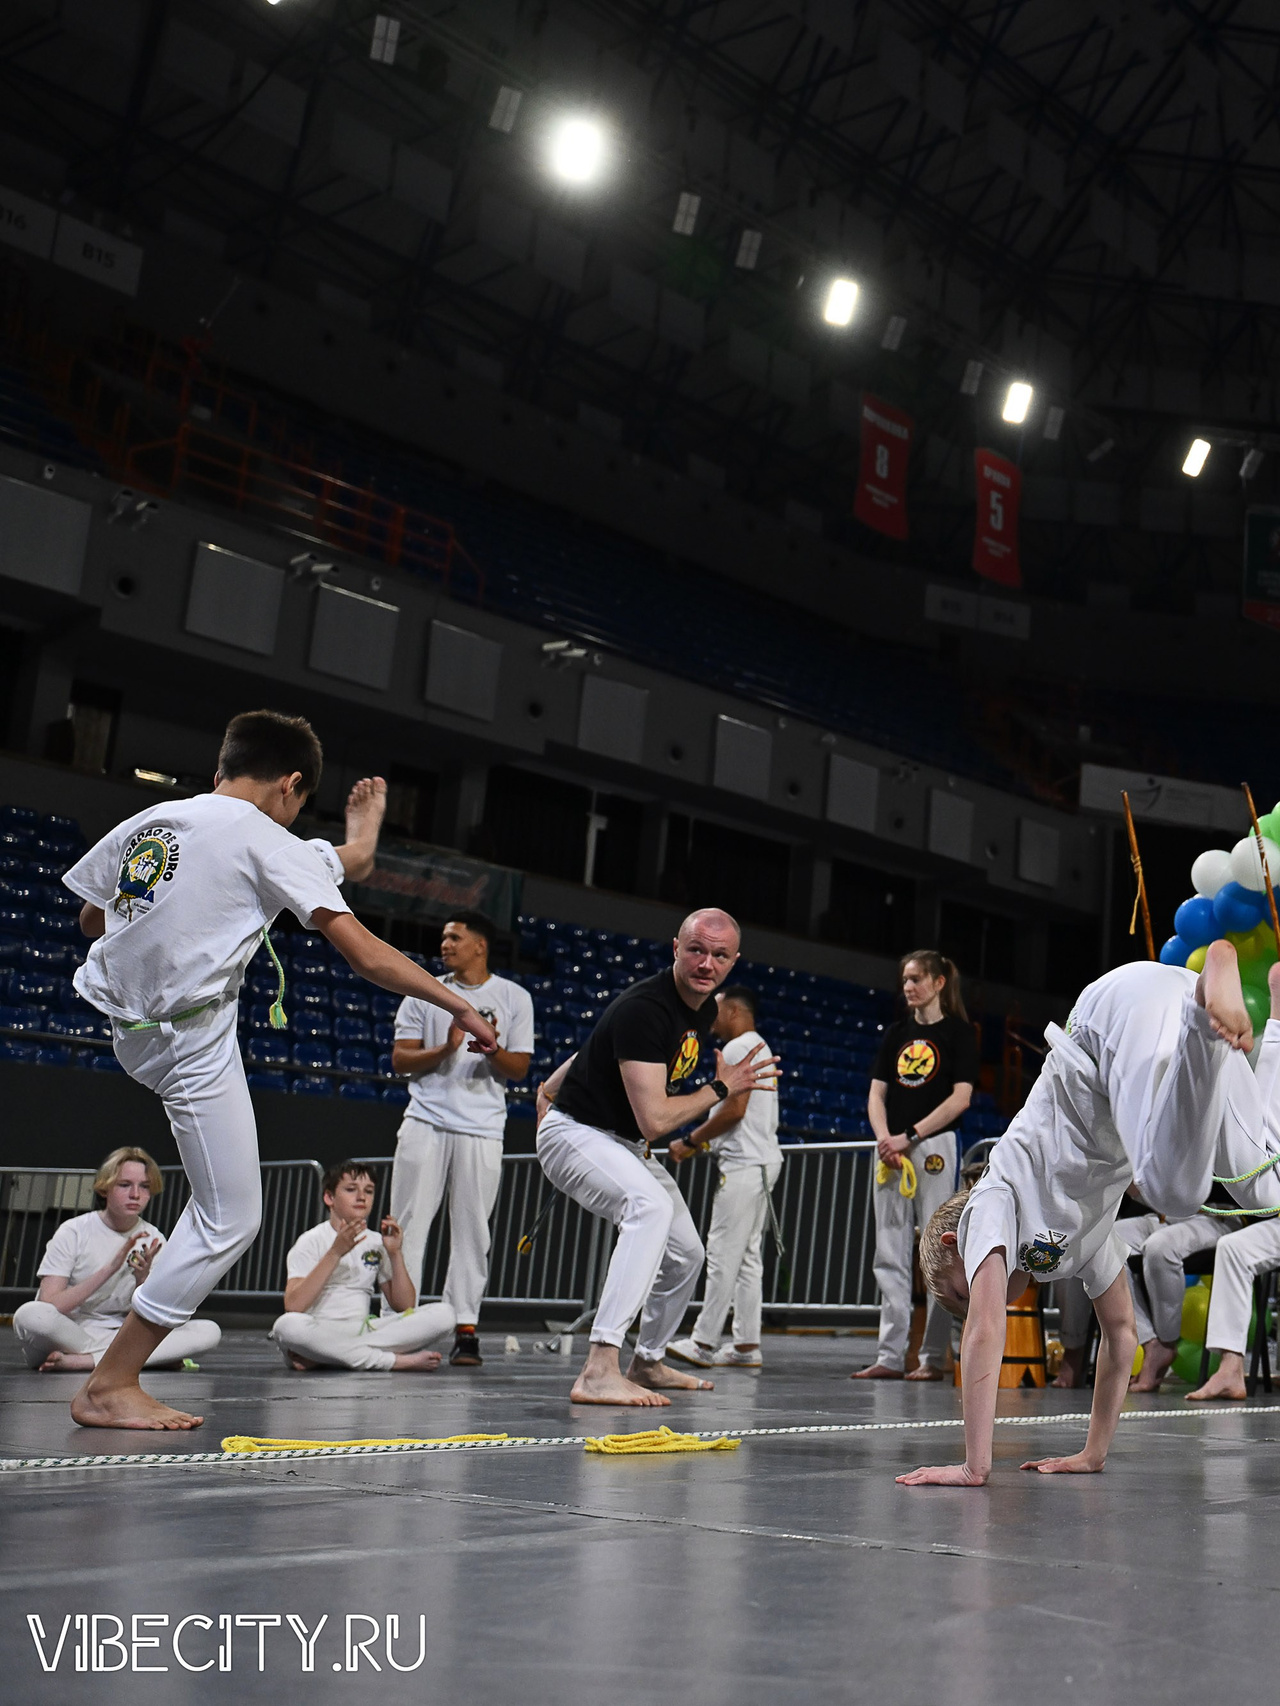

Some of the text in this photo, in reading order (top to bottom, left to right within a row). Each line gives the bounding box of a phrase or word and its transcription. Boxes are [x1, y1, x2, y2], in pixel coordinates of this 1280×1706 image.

[875, 443, 890, 479] 8
[989, 489, 1004, 532] 5
[161, 832, 177, 845] DE
[163, 843, 179, 882] OURO
